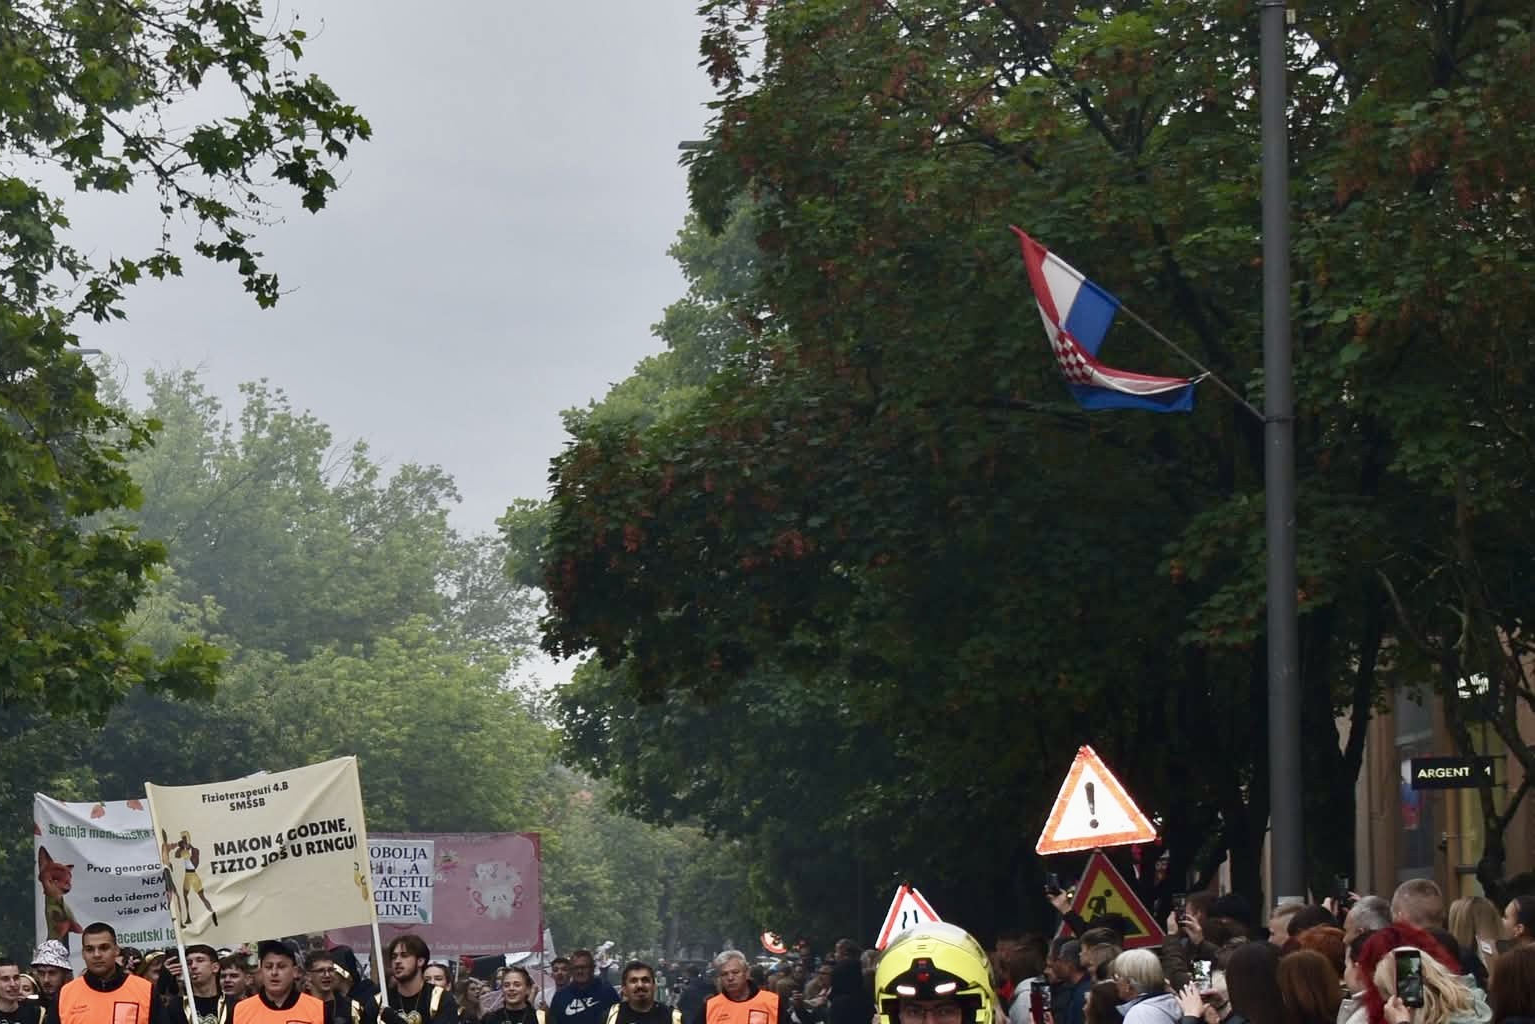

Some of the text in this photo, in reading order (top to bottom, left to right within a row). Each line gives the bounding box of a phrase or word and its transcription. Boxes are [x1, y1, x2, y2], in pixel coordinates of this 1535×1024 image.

[213, 817, 352, 857] NAKON 4 GODINE,
[210, 856, 257, 875] FIZIO
[261, 845, 288, 868] JOŠ
[290, 843, 303, 857] U
[87, 863, 112, 874] Prva
[93, 892, 160, 903] sada idemo
[117, 907, 140, 916] više
[143, 905, 158, 913] od
